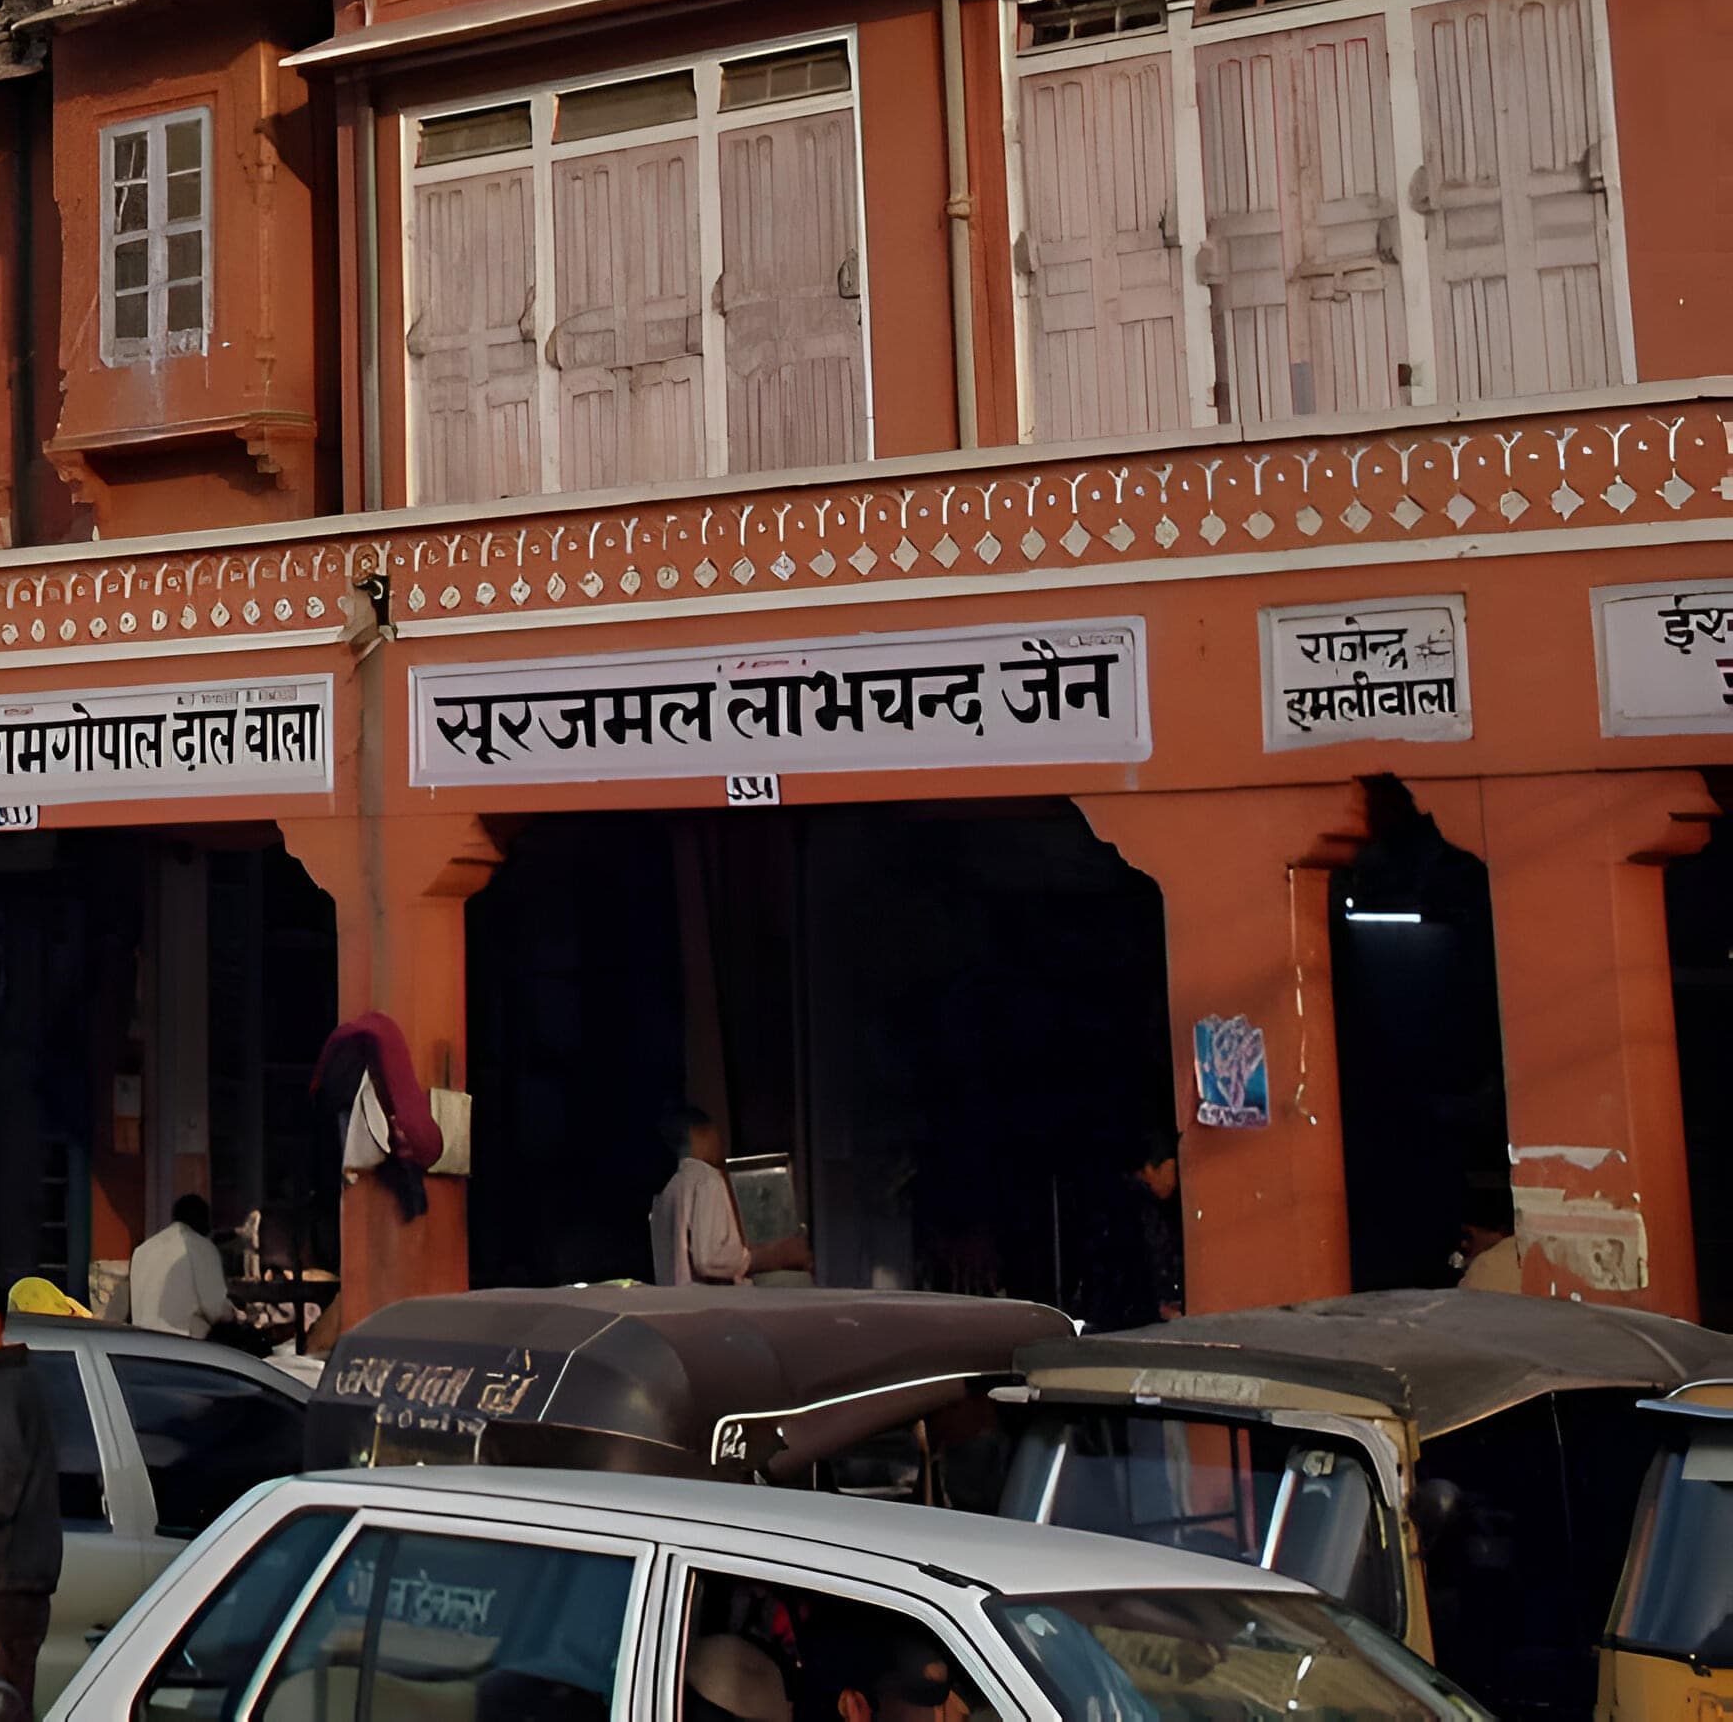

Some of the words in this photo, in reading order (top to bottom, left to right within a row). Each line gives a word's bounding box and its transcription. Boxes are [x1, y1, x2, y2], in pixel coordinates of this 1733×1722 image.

[434, 682, 716, 764] सूरजमल
[1000, 640, 1118, 723] जैन
[1284, 671, 1455, 732] इमलीवाला
[244, 704, 320, 762] वाला
